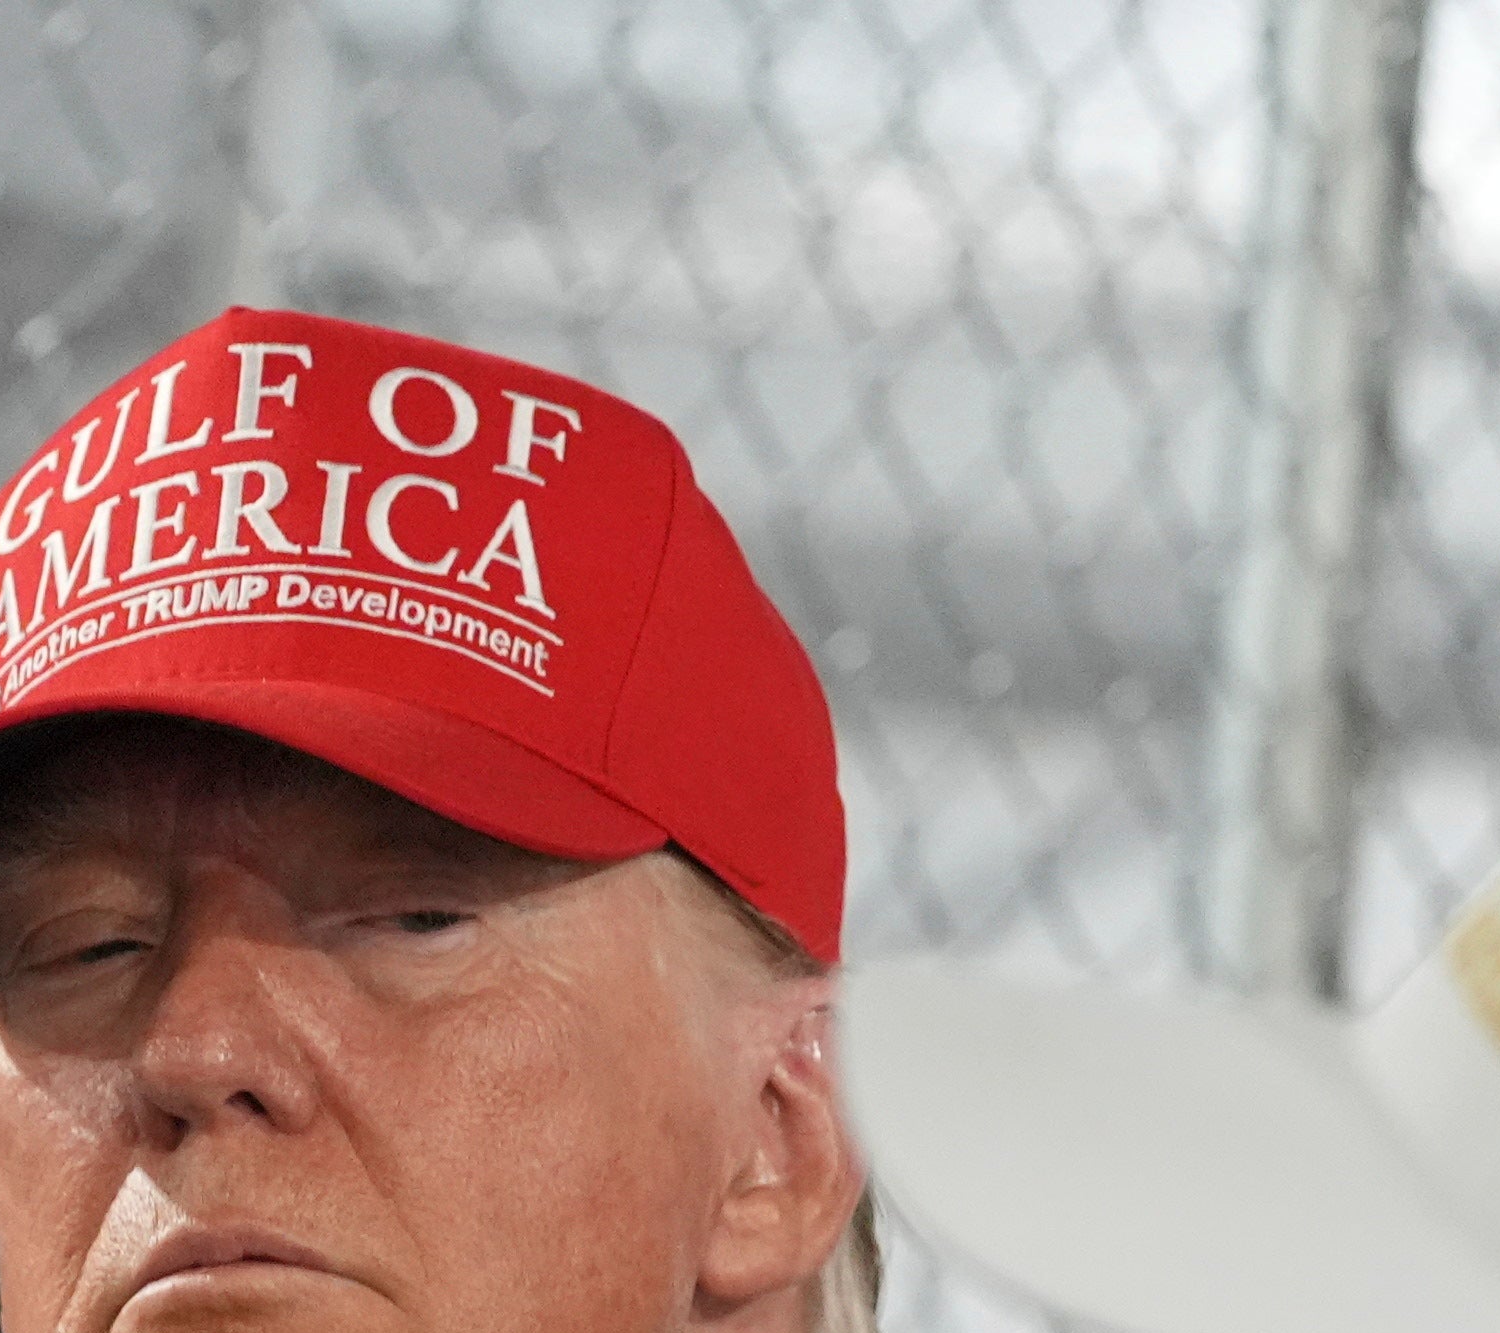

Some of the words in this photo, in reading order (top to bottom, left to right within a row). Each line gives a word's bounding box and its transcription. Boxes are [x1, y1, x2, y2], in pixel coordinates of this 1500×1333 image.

[369, 367, 583, 486] OF
[1, 611, 117, 704] Another
[120, 573, 270, 630] TRUMP
[276, 573, 550, 678] Development
